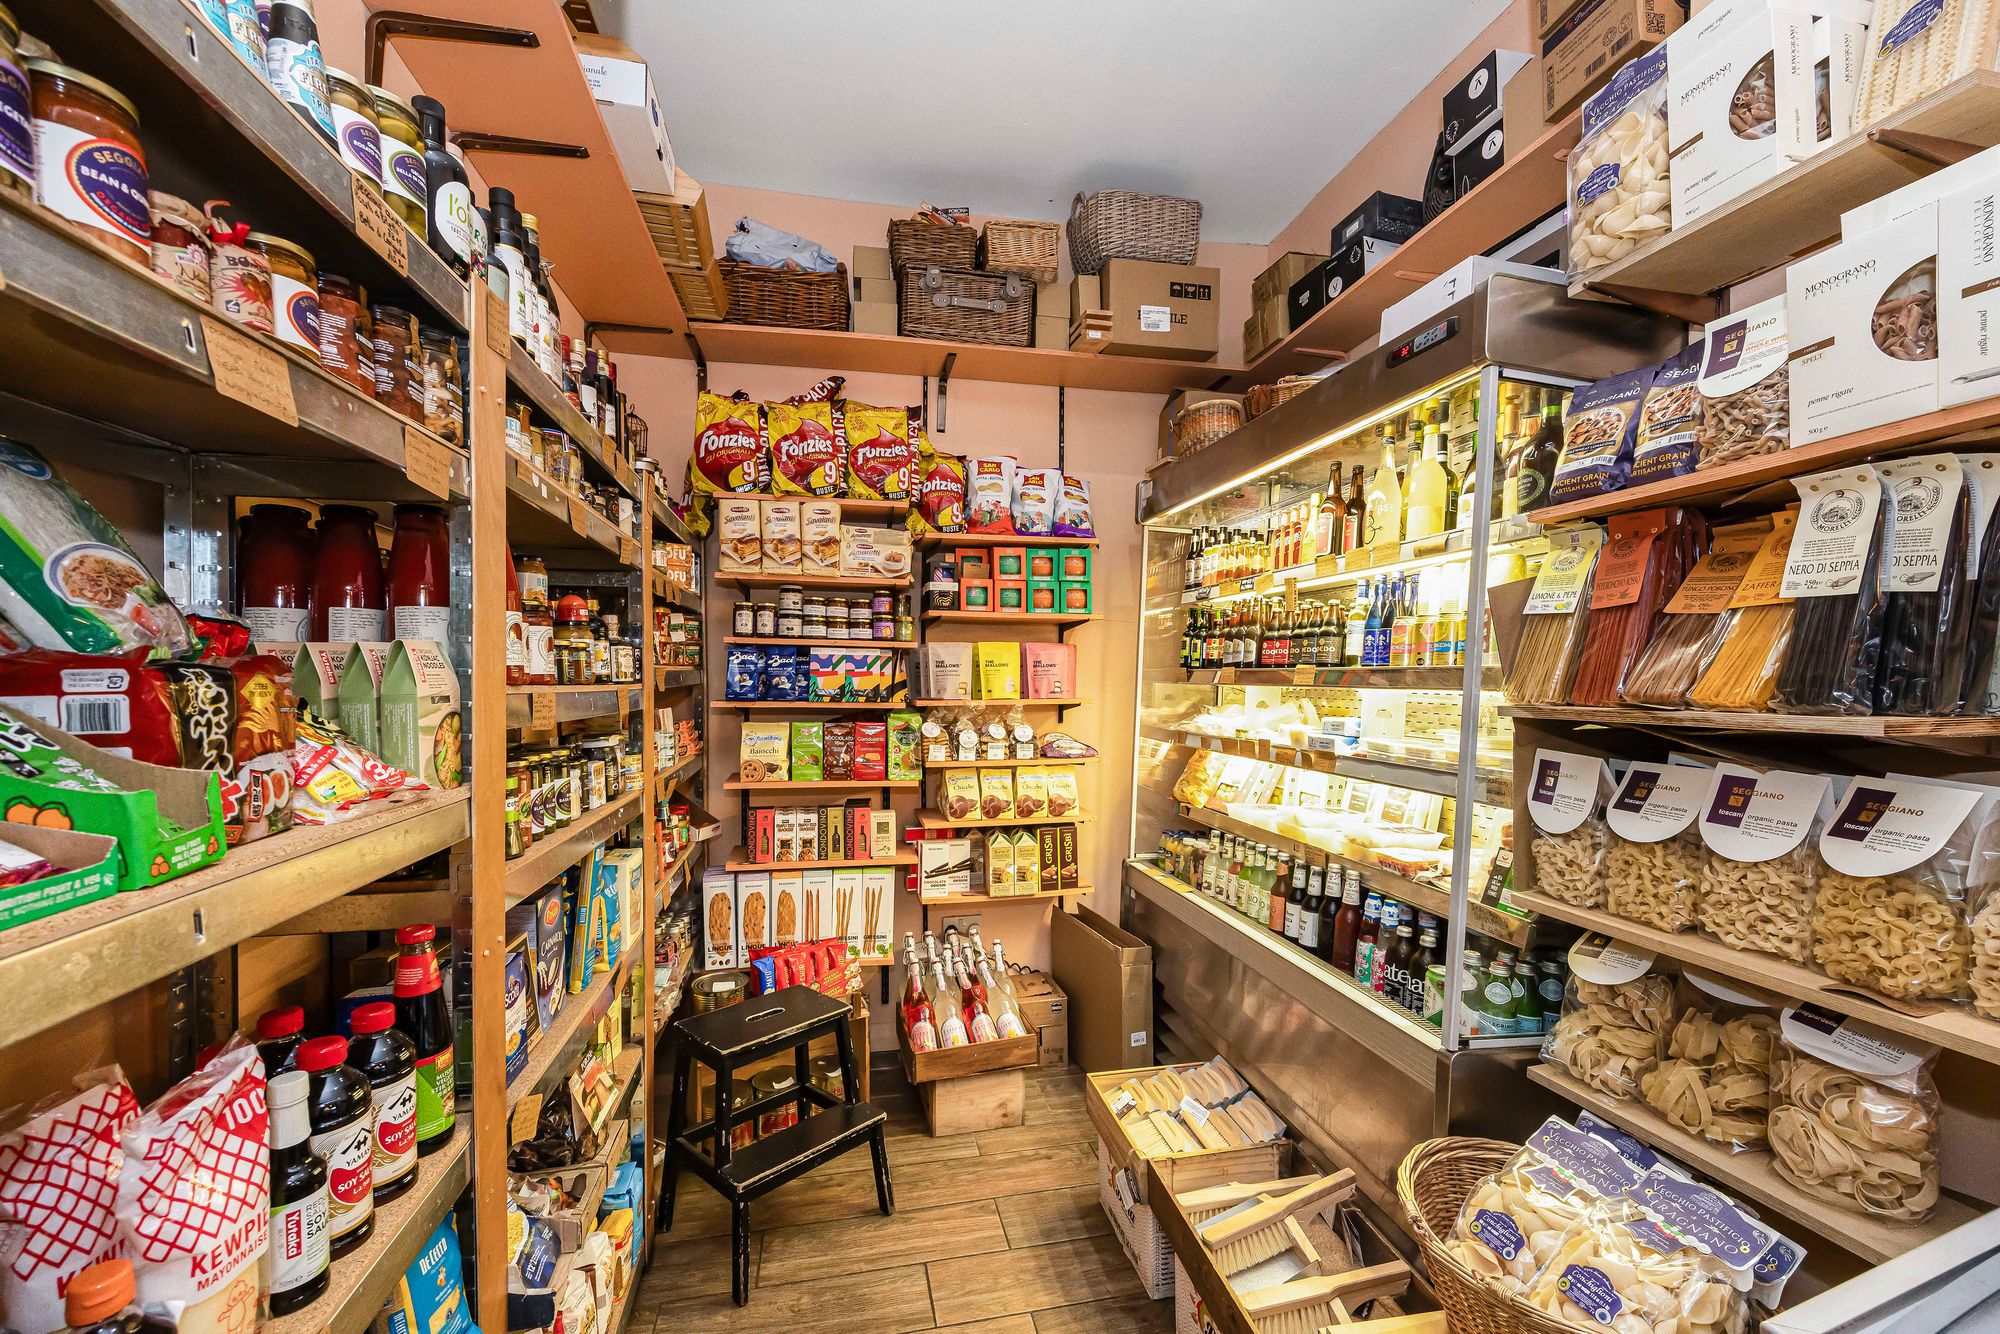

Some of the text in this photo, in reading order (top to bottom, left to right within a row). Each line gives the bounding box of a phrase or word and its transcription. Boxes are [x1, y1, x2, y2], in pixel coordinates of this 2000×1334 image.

[1698, 21, 1716, 38] penne
[583, 64, 608, 76] ianale
[1590, 88, 1622, 117] VECCHIO
[1624, 59, 1665, 91] PASTIFICIO
[1680, 62, 1732, 101] MONOGRANO
[1680, 147, 1697, 162] SPELT
[80, 165, 130, 194] BEAN &
[1684, 170, 1718, 194] penne rigate
[1982, 194, 1995, 263] MONOGRANO
[1805, 259, 1876, 295] MONOGRANO
[1805, 268, 1876, 300] FELICETTI
[1725, 317, 1777, 342] SEGGIANO
[1978, 310, 1987, 356] penne rigate
[1745, 339, 1770, 352] WHOLE
[1801, 353, 1823, 366] SPELT
[1584, 387, 1641, 409] SEGGIANO
[1808, 386, 1854, 407] penne rigate
[1808, 428, 1819, 436] 500
[700, 431, 756, 458] Fonzies
[716, 448, 751, 457] ORIGINALI
[781, 437, 833, 461] Fonzies
[857, 444, 908, 465] Fonzies
[1659, 451, 1691, 463] GRAIN
[742, 460, 755, 481] 9
[824, 461, 837, 483] 9
[1657, 461, 1683, 472] PASTA
[898, 467, 910, 490] 9
[1582, 472, 1610, 483] GRAIN
[816, 486, 834, 496] BUSTE
[888, 491, 907, 499] BUSTE
[1555, 481, 1604, 495] ARTISAN PASTA
[951, 502, 963, 523] 9
[1818, 517, 1851, 533] MORELLI
[1788, 559, 1860, 576] NERO DI SEPPIA
[1903, 554, 1938, 567] SEPPIA
[1531, 592, 1556, 601] LIMONE
[1563, 590, 1578, 600] PEPE
[1682, 585, 1705, 593] FUNGO
[412, 648, 426, 682] Yutaka
[730, 651, 757, 663] Baci
[768, 655, 794, 667] Baci
[319, 651, 336, 684] Yutaka
[750, 747, 779, 755] Baiocchi
[1547, 769, 1578, 781] SEGGIANO
[1639, 781, 1681, 793] SEGGIANO
[1732, 786, 1784, 801] SEGGIANO
[1556, 793, 1587, 804] organic pasta
[1624, 797, 1645, 805] toscani
[1648, 801, 1688, 814] organic pasta
[1718, 808, 1744, 818] toscani
[1866, 801, 1924, 817] SEGGIANO
[1747, 814, 1798, 829] organic pasta
[1843, 822, 1872, 833] toscani
[748, 810, 756, 861] MONDOVINO
[1741, 830, 1754, 838] 375g
[1875, 828, 1931, 843] organic pasta
[1863, 843, 1878, 852] 375g
[1604, 948, 1644, 961] organic pasta
[765, 970, 773, 987] MAYO
[1796, 1006, 1839, 1028] pappardelle
[1831, 1038, 1849, 1051] 375g
[1843, 1026, 1906, 1057] organic pasta
[385, 1131, 403, 1145] SOY
[1543, 1138, 1621, 1195] GRAGNANO
[1549, 1129, 1631, 1190] VECCHIO PASTIFICIO
[338, 1176, 358, 1194] SOY
[307, 1211, 327, 1230] SOY
[1652, 1181, 1751, 1249] VECCHIO PASTIFICIO
[1482, 1214, 1518, 1242] Conchiglioni
[1647, 1193, 1738, 1256] GRAGNANO
[191, 1206, 268, 1278] KEWPIE
[287, 1211, 300, 1257] Yutaka
[197, 1234, 268, 1291] MAYONNAISE
[419, 1237, 448, 1275] DE CECCO
[1572, 1269, 1613, 1302] Conchiglioni
